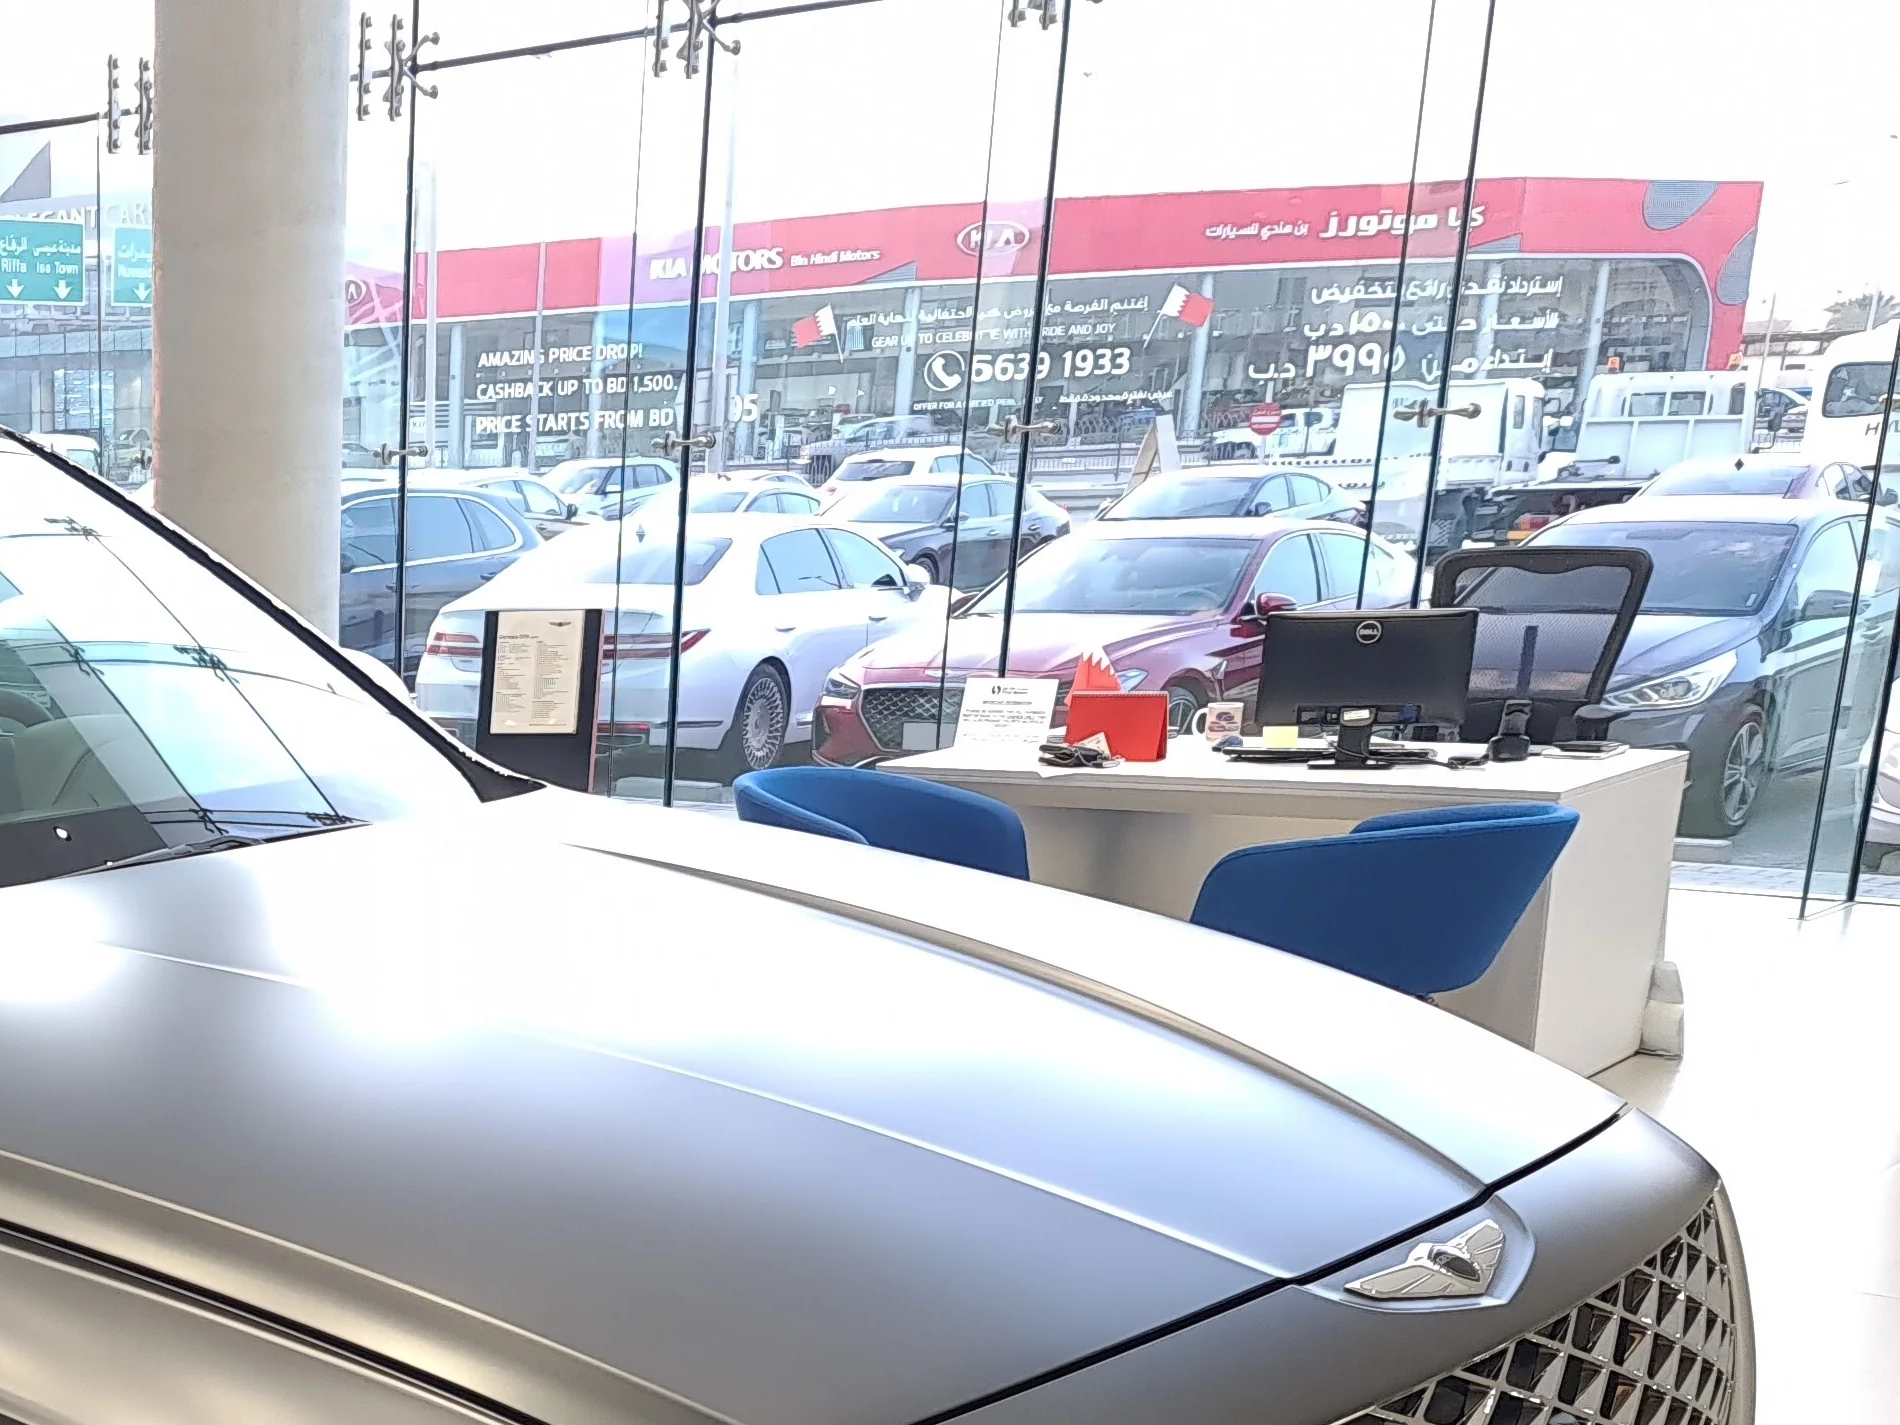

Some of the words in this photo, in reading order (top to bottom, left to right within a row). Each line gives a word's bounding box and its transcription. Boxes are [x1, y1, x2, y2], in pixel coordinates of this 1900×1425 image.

[1, 258, 27, 273] Riffa
[53, 261, 79, 274] Town
[650, 257, 687, 280] KIA
[839, 249, 881, 264] Motors
[871, 335, 899, 348] GEAR
[918, 332, 934, 344] TO
[1003, 327, 1032, 340] WITH
[1042, 325, 1066, 337] RIDE
[1068, 324, 1093, 336] AND
[1094, 322, 1117, 335] JOY
[548, 345, 592, 364] PRICE
[596, 342, 643, 360] DROP!
[1062, 347, 1131, 378] 1933
[476, 381, 554, 401] CASHBACK
[557, 379, 579, 396] UP
[582, 377, 604, 395] TO
[606, 376, 627, 394] BD
[476, 415, 522, 435] PRICE
[525, 411, 590, 432] STARTS
[594, 408, 644, 430] FROM
[648, 407, 675, 427] BD
